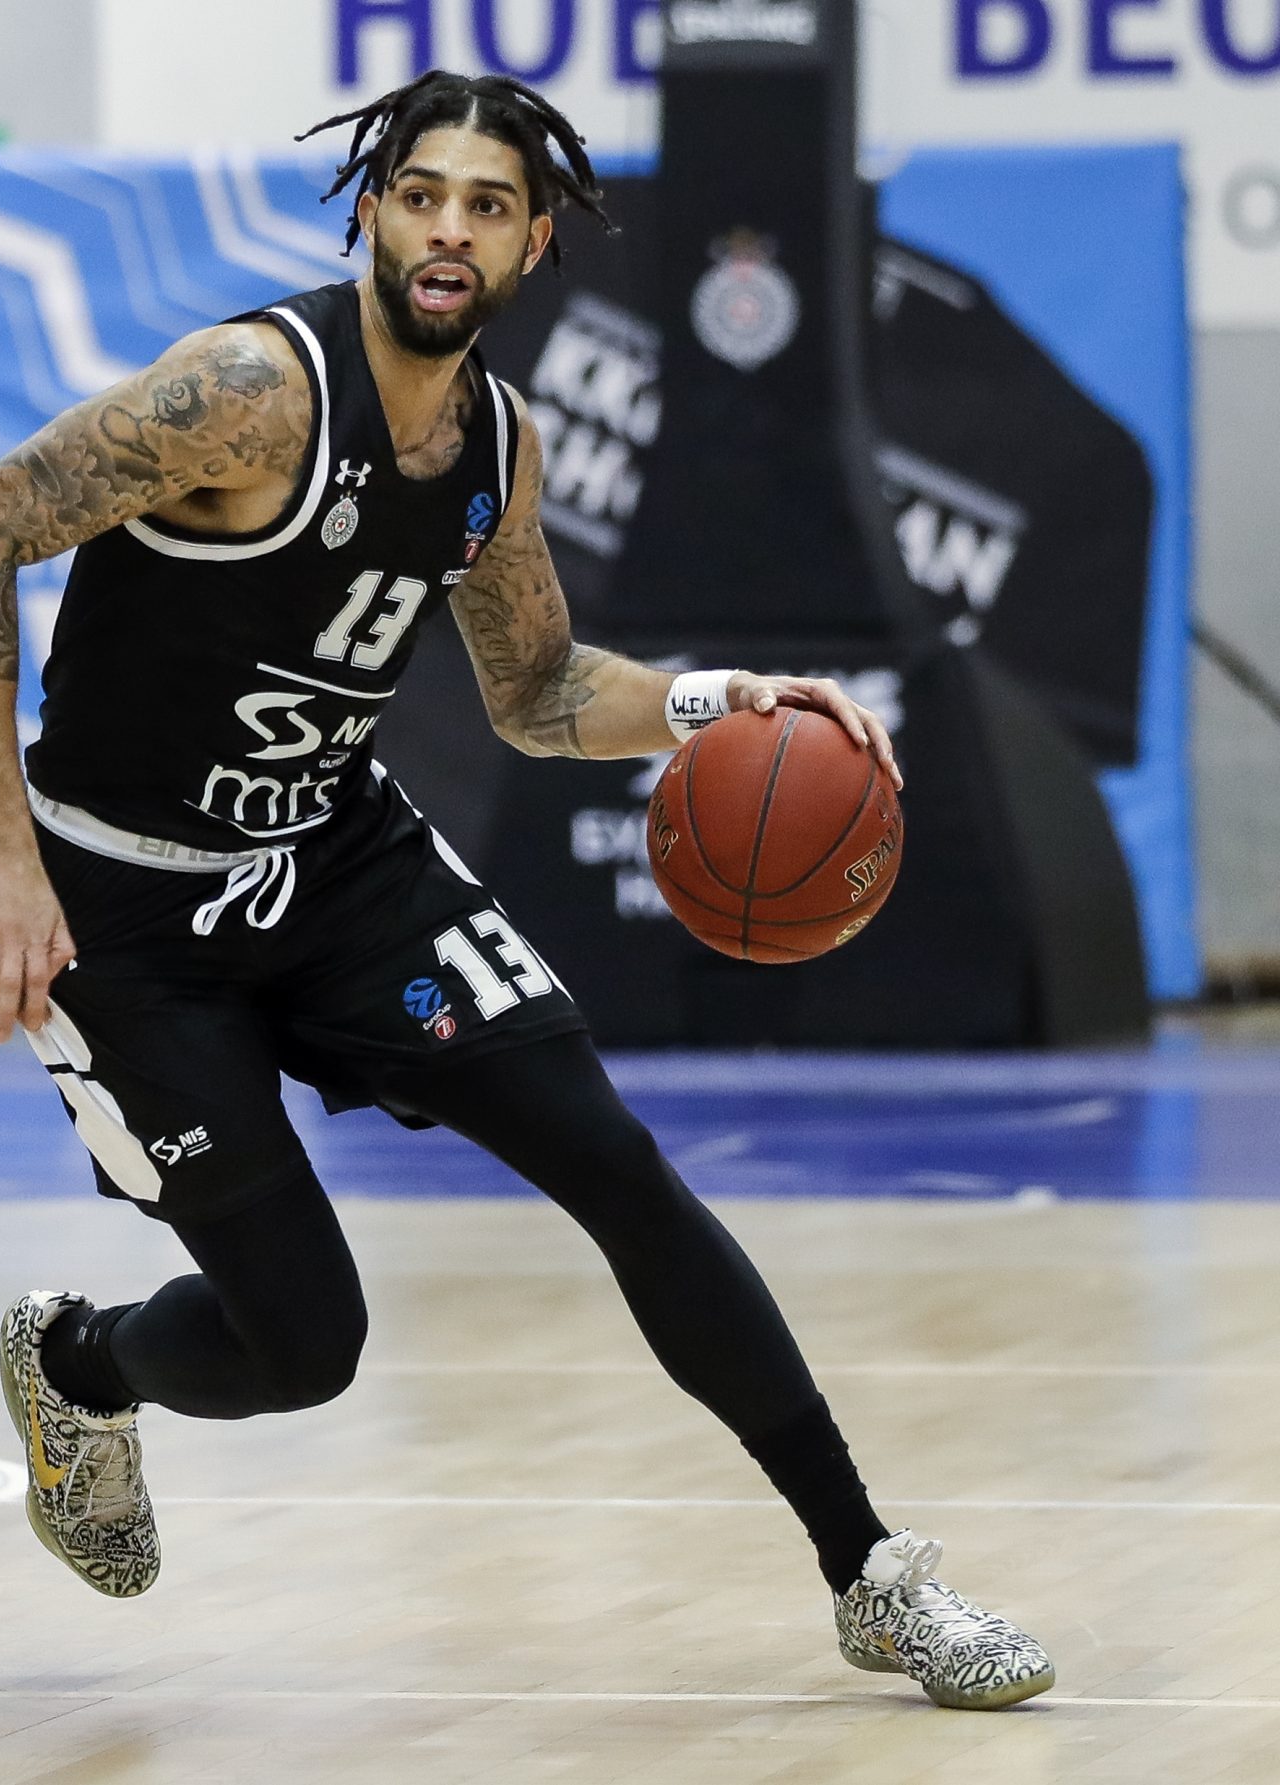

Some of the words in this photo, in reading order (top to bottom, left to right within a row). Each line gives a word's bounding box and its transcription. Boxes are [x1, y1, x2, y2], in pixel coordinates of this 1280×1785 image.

[313, 570, 428, 671] 13
[199, 764, 340, 826] mts
[433, 909, 553, 1022] 13
[423, 1003, 451, 1031] EuroCup
[178, 1125, 207, 1148] NIS
